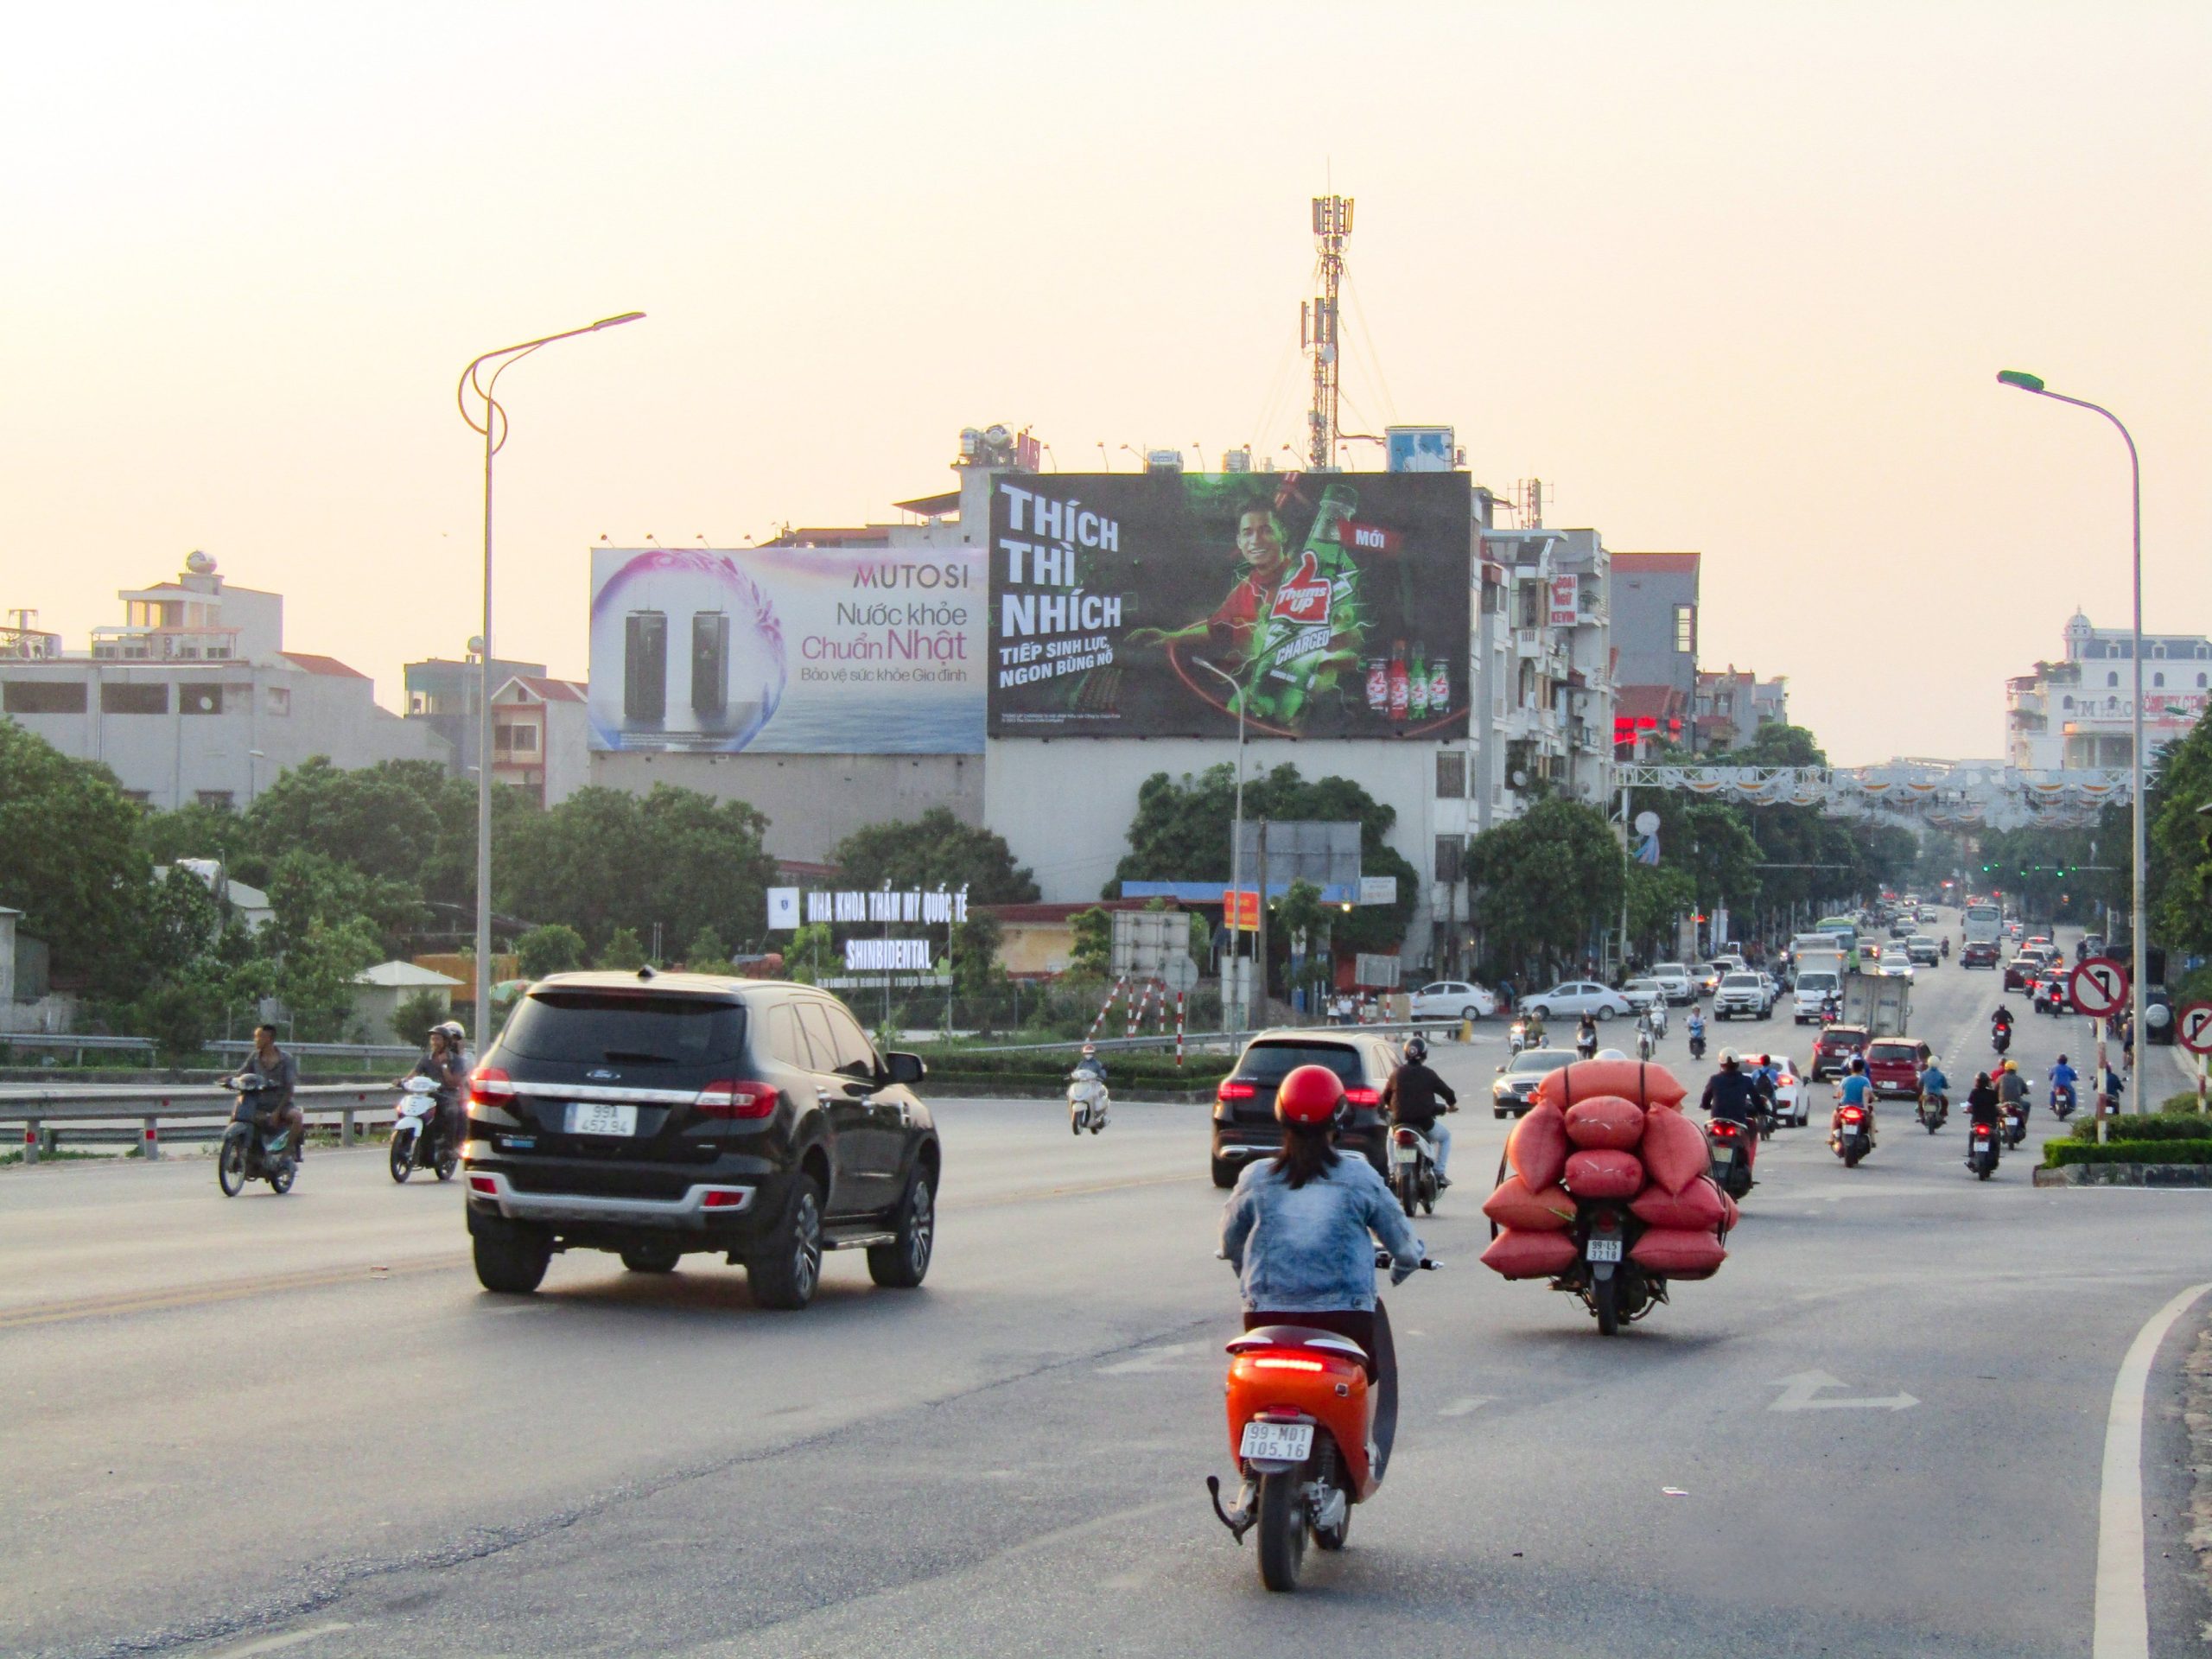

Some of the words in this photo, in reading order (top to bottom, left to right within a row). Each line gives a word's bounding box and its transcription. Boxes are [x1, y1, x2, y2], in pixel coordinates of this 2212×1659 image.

[1000, 483, 1119, 552] THÍCH
[1356, 529, 1384, 549] MỚI
[853, 564, 969, 589] MUTOSI
[999, 538, 1075, 587] THÌ
[1278, 587, 1327, 604] Thums
[837, 602, 902, 626] Nước
[908, 601, 968, 626] khỏe
[1001, 588, 1122, 638] NHÍCH
[802, 632, 882, 660] Chuẩn
[887, 628, 967, 666] Nhật
[999, 641, 1043, 666] TIẾP
[1046, 639, 1082, 658] SINH
[1275, 629, 1331, 666] CHARGED
[801, 667, 830, 682] Bảo
[849, 669, 874, 682] sức
[912, 668, 935, 682] Gia
[1000, 663, 1052, 689] NGON
[1056, 656, 1094, 676] BÙNG
[807, 892, 832, 922] NHA
[835, 892, 866, 921] KHOA
[922, 882, 951, 925] QUỐC
[954, 883, 969, 922] TẾ
[846, 939, 931, 970] SHINBIDENTAL
[1249, 1441, 1305, 1458] 105.16
